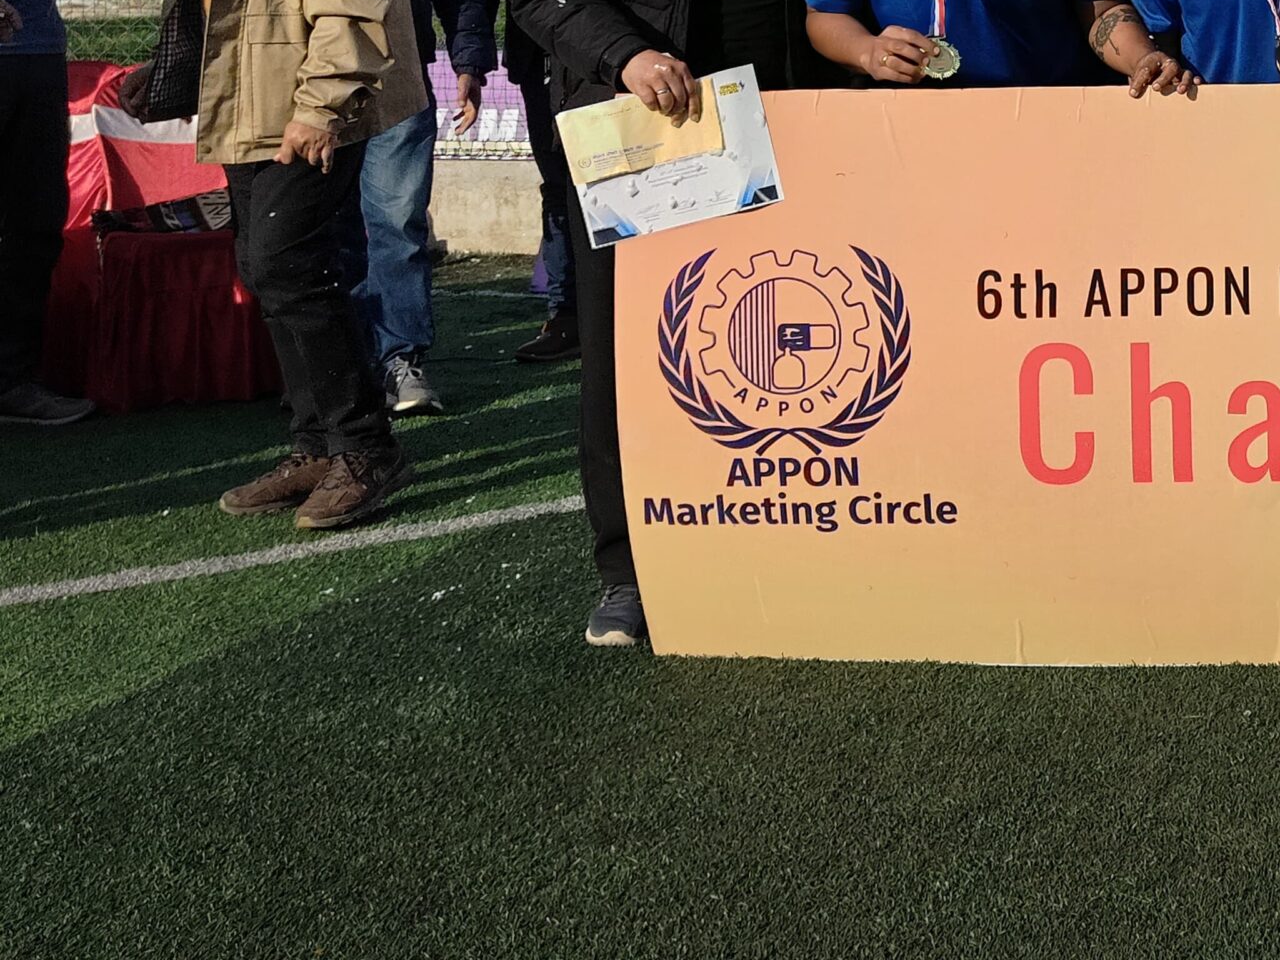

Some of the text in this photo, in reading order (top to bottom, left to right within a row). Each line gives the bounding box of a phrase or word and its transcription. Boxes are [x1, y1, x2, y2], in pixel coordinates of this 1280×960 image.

[976, 269, 1058, 320] 6th
[1084, 266, 1251, 318] APPON
[734, 386, 838, 417] APPON
[726, 456, 859, 487] APPON
[643, 492, 958, 533] Marketing Circle
